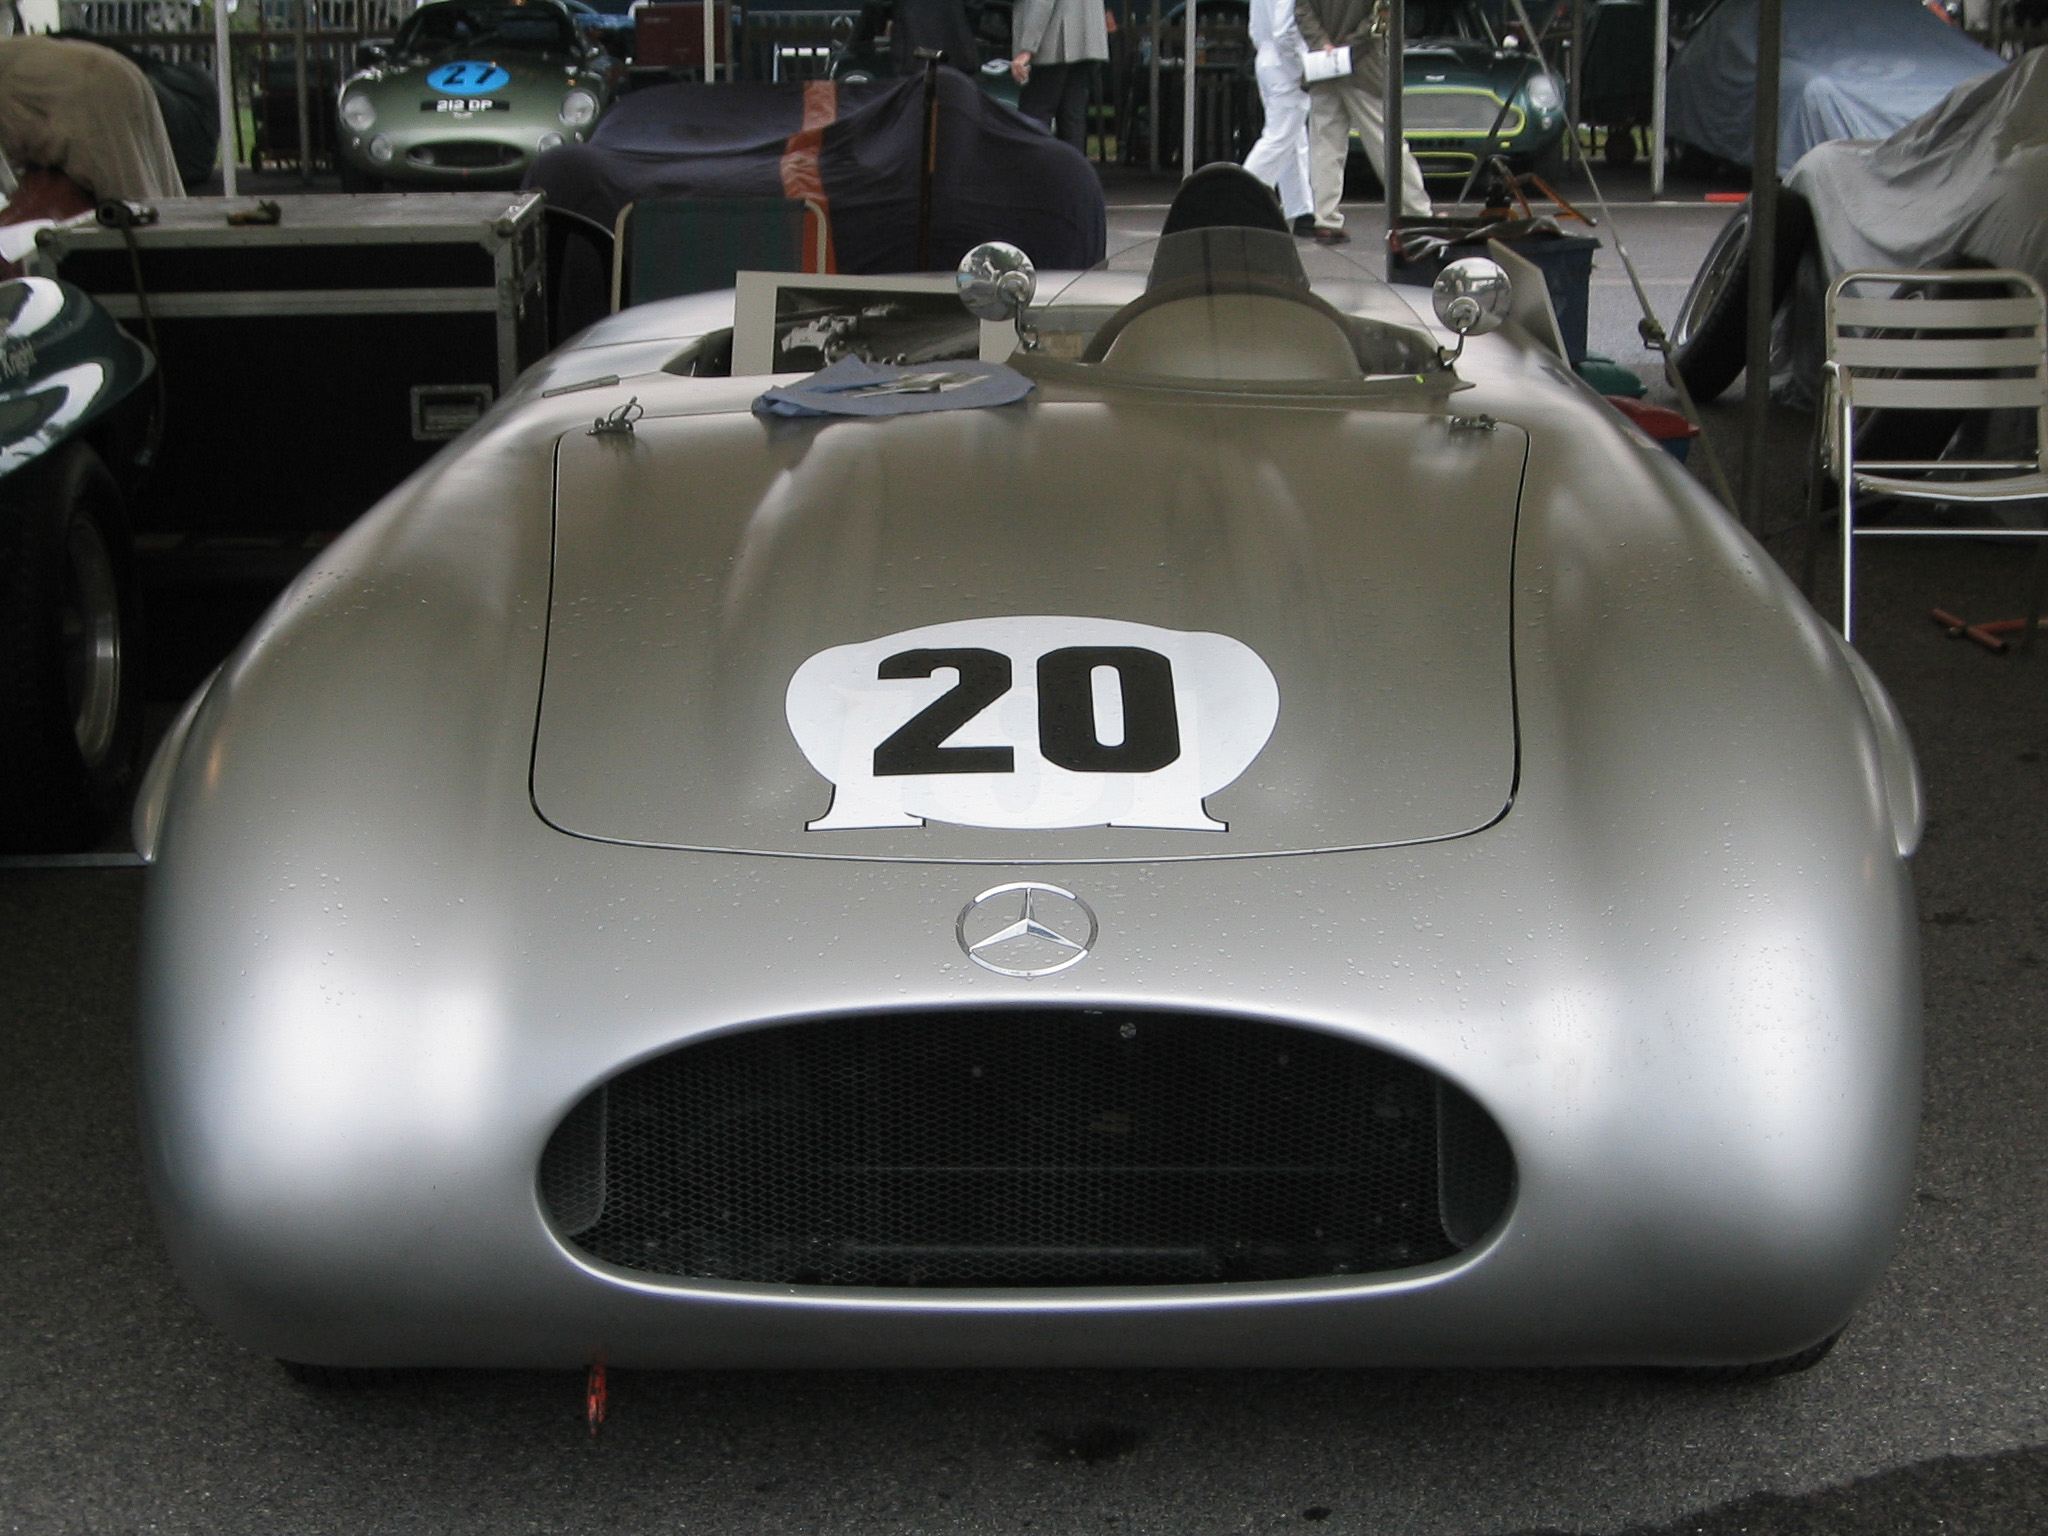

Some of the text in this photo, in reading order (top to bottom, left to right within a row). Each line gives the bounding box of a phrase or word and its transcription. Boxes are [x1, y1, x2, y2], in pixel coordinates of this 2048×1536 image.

[443, 65, 497, 85] 27
[469, 99, 493, 113] DP
[873, 646, 1180, 776] 20
